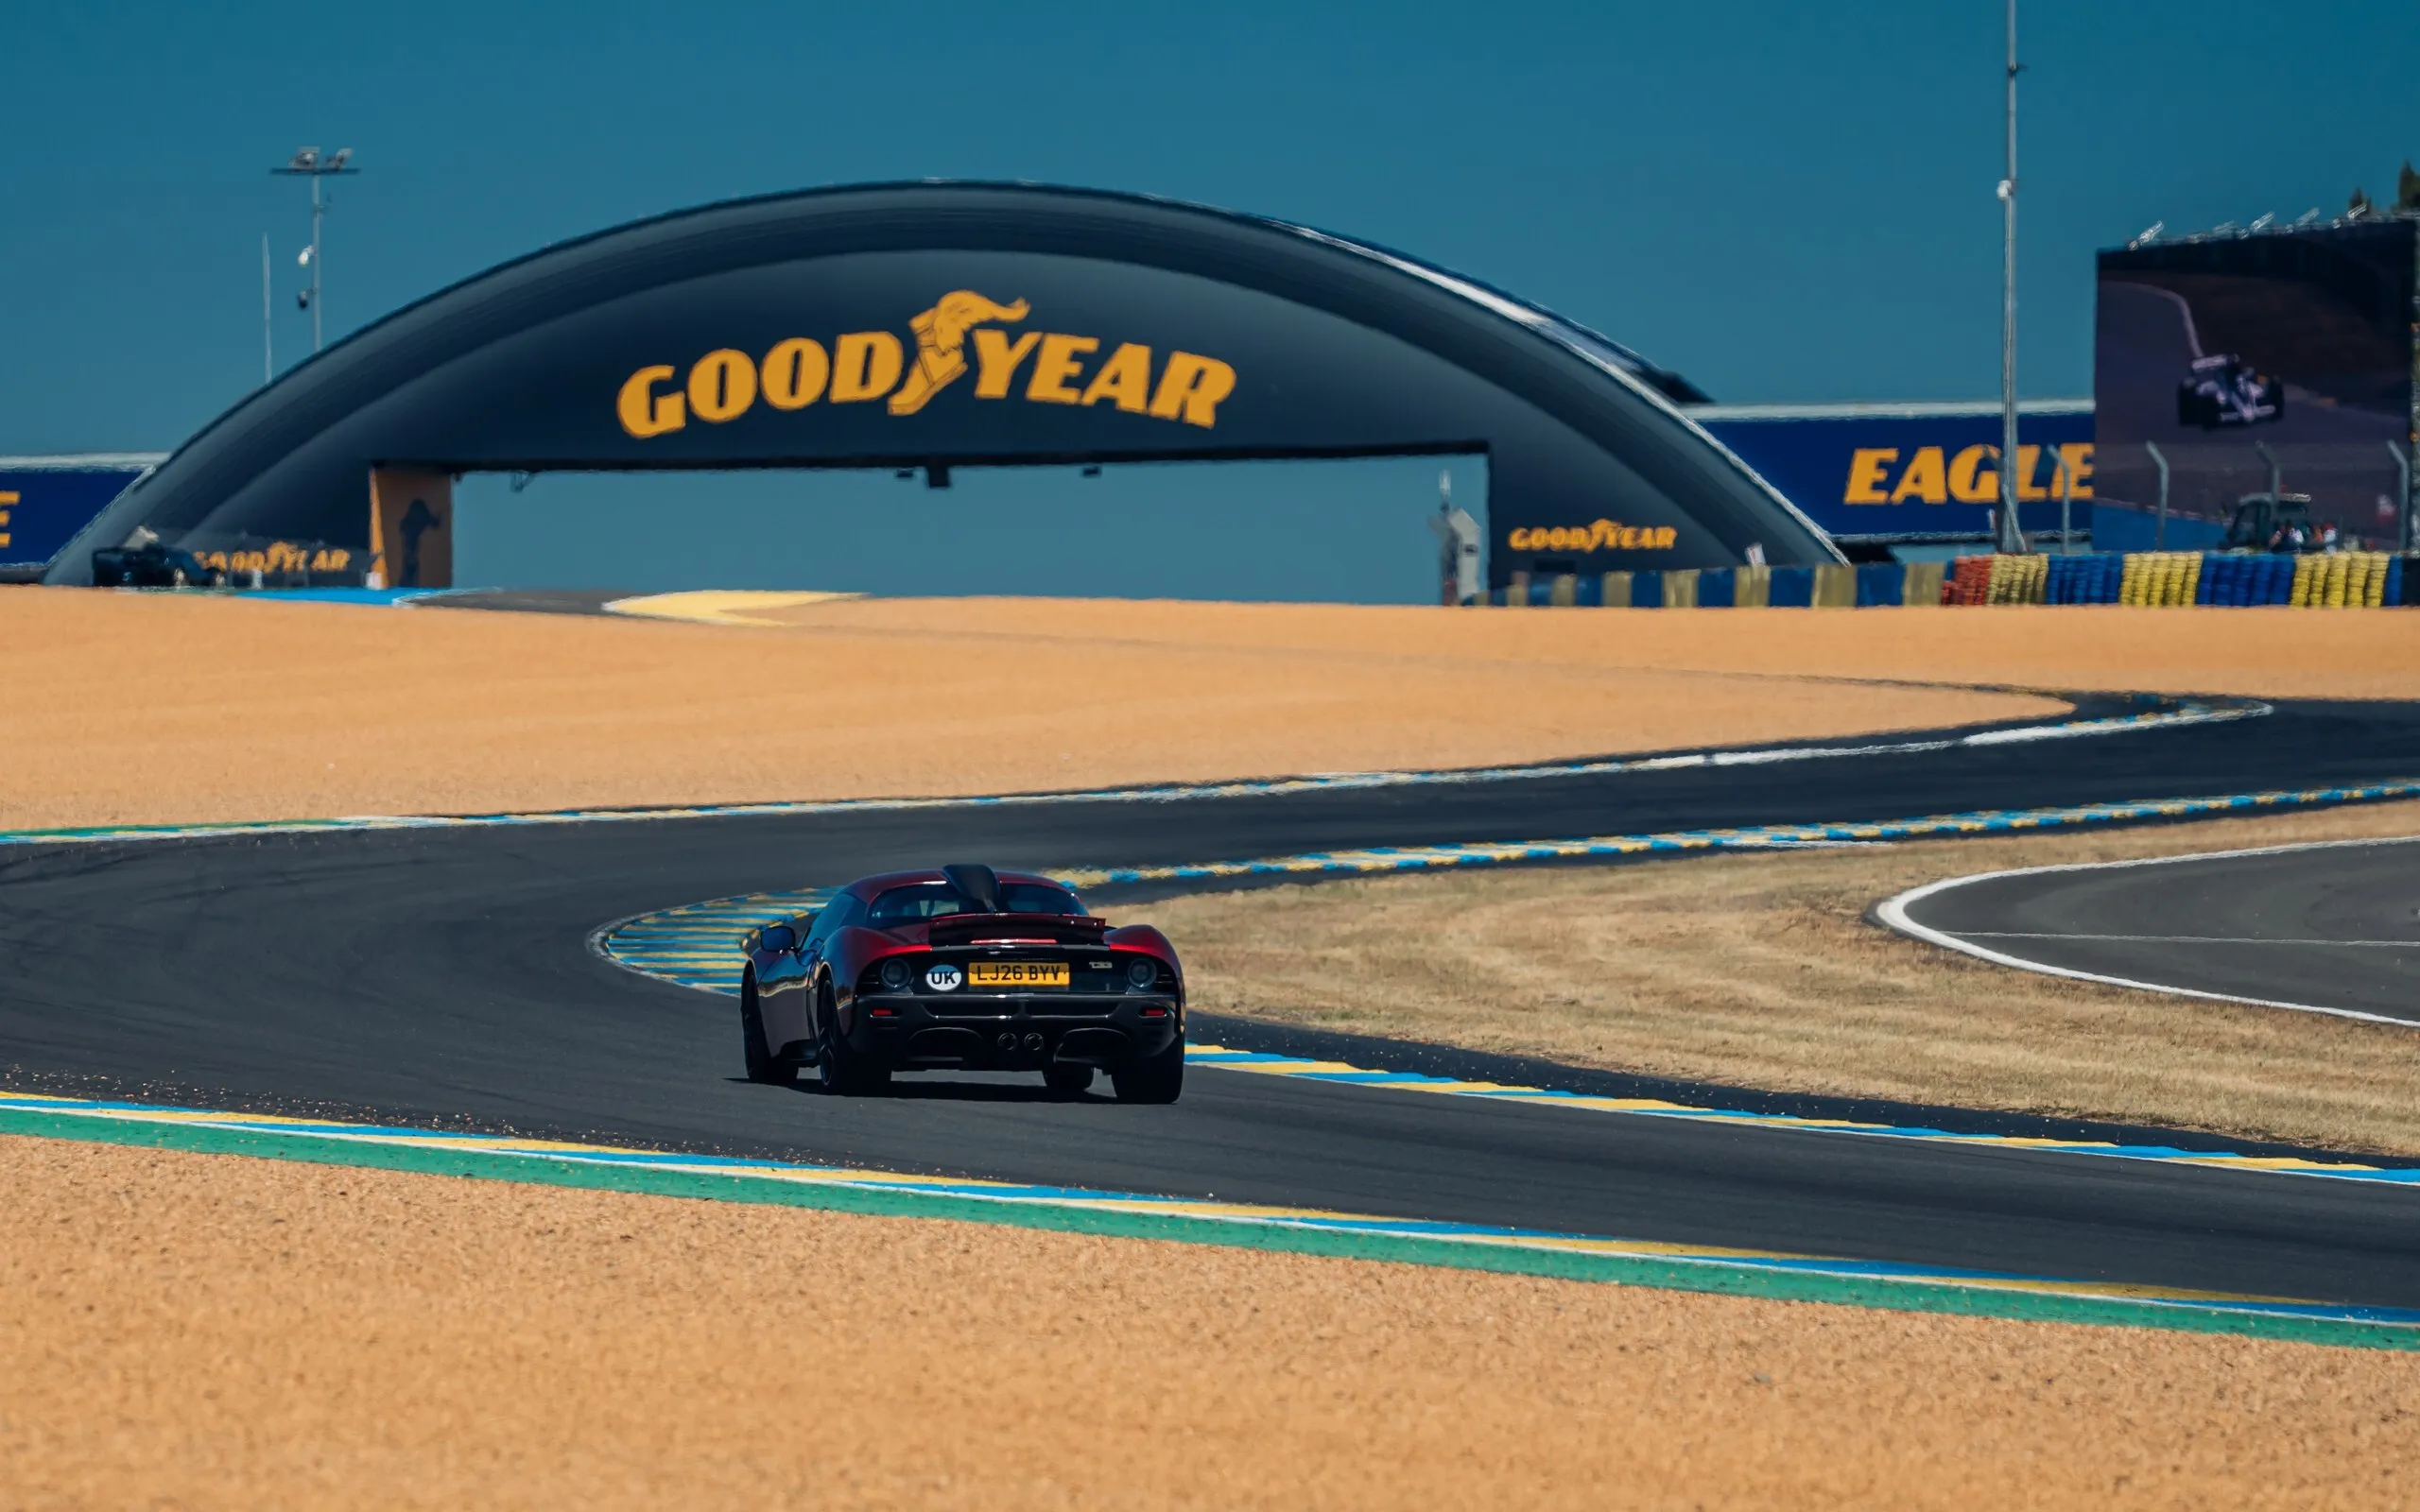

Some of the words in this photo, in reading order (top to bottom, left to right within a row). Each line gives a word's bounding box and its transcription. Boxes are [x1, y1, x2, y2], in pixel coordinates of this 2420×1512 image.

[616, 329, 1237, 439] GOODYEAR
[1843, 443, 2095, 505] EAGLE
[1509, 524, 1678, 551] GOODYEAR
[931, 971, 957, 985] UK
[977, 965, 1023, 981] LJ26
[1028, 965, 1061, 981] BYV
